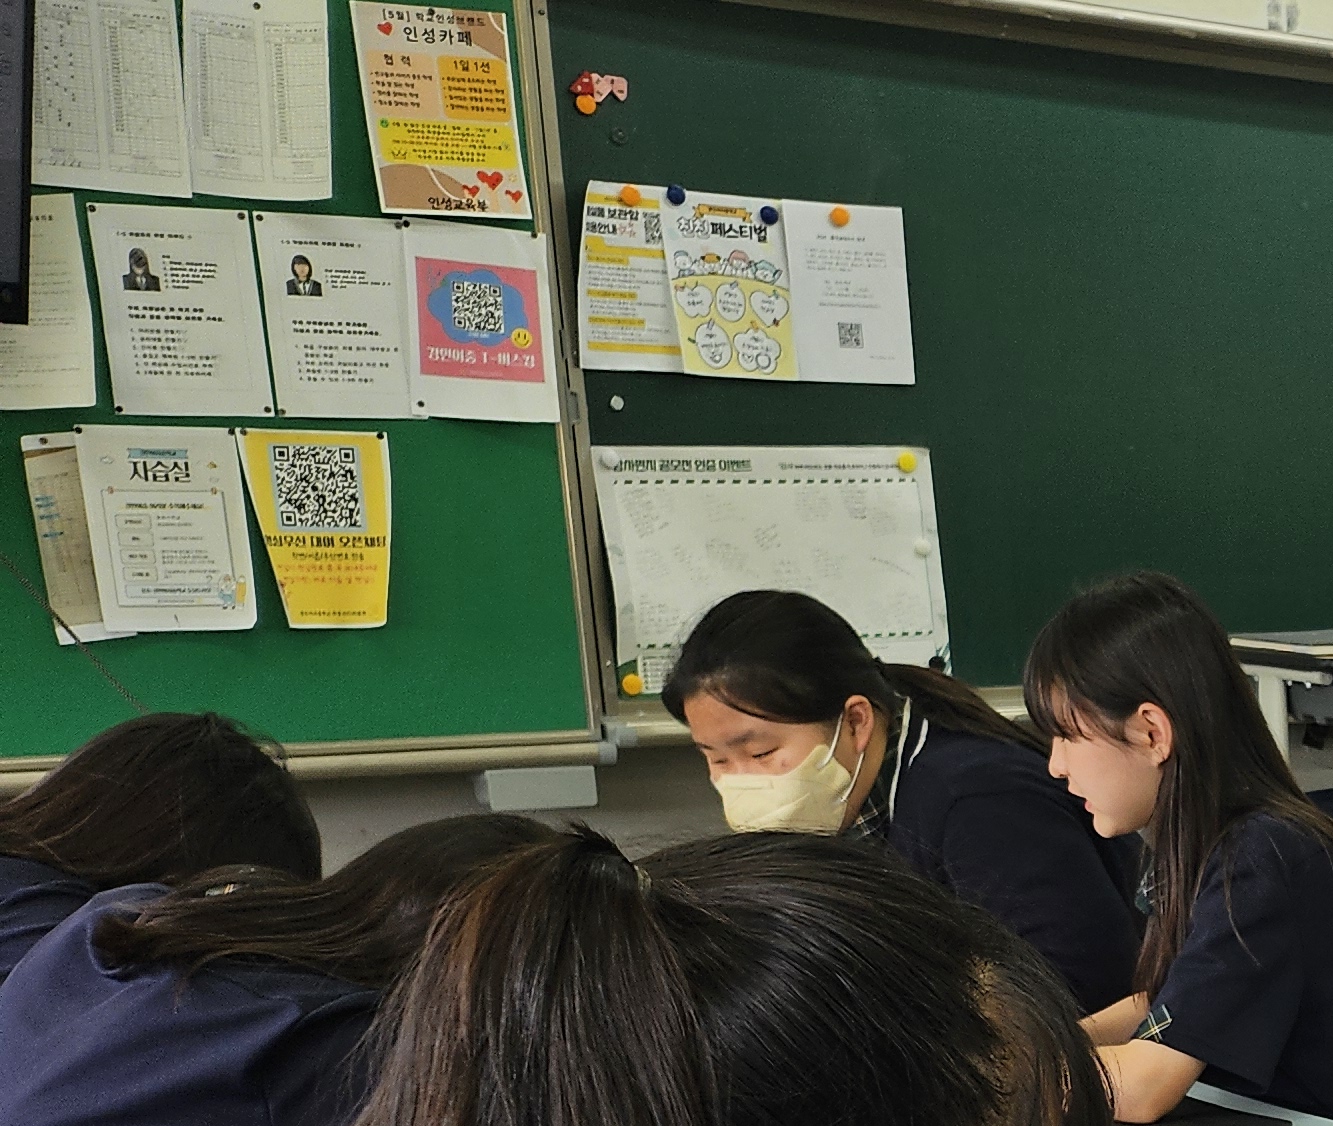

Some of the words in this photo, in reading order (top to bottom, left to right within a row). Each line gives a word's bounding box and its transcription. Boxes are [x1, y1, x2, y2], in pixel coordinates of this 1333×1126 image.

[403, 26, 473, 47] 인성카페
[428, 196, 489, 212] 인성교육부
[129, 461, 191, 483] 자습실
[718, 459, 752, 472] 이벤트
